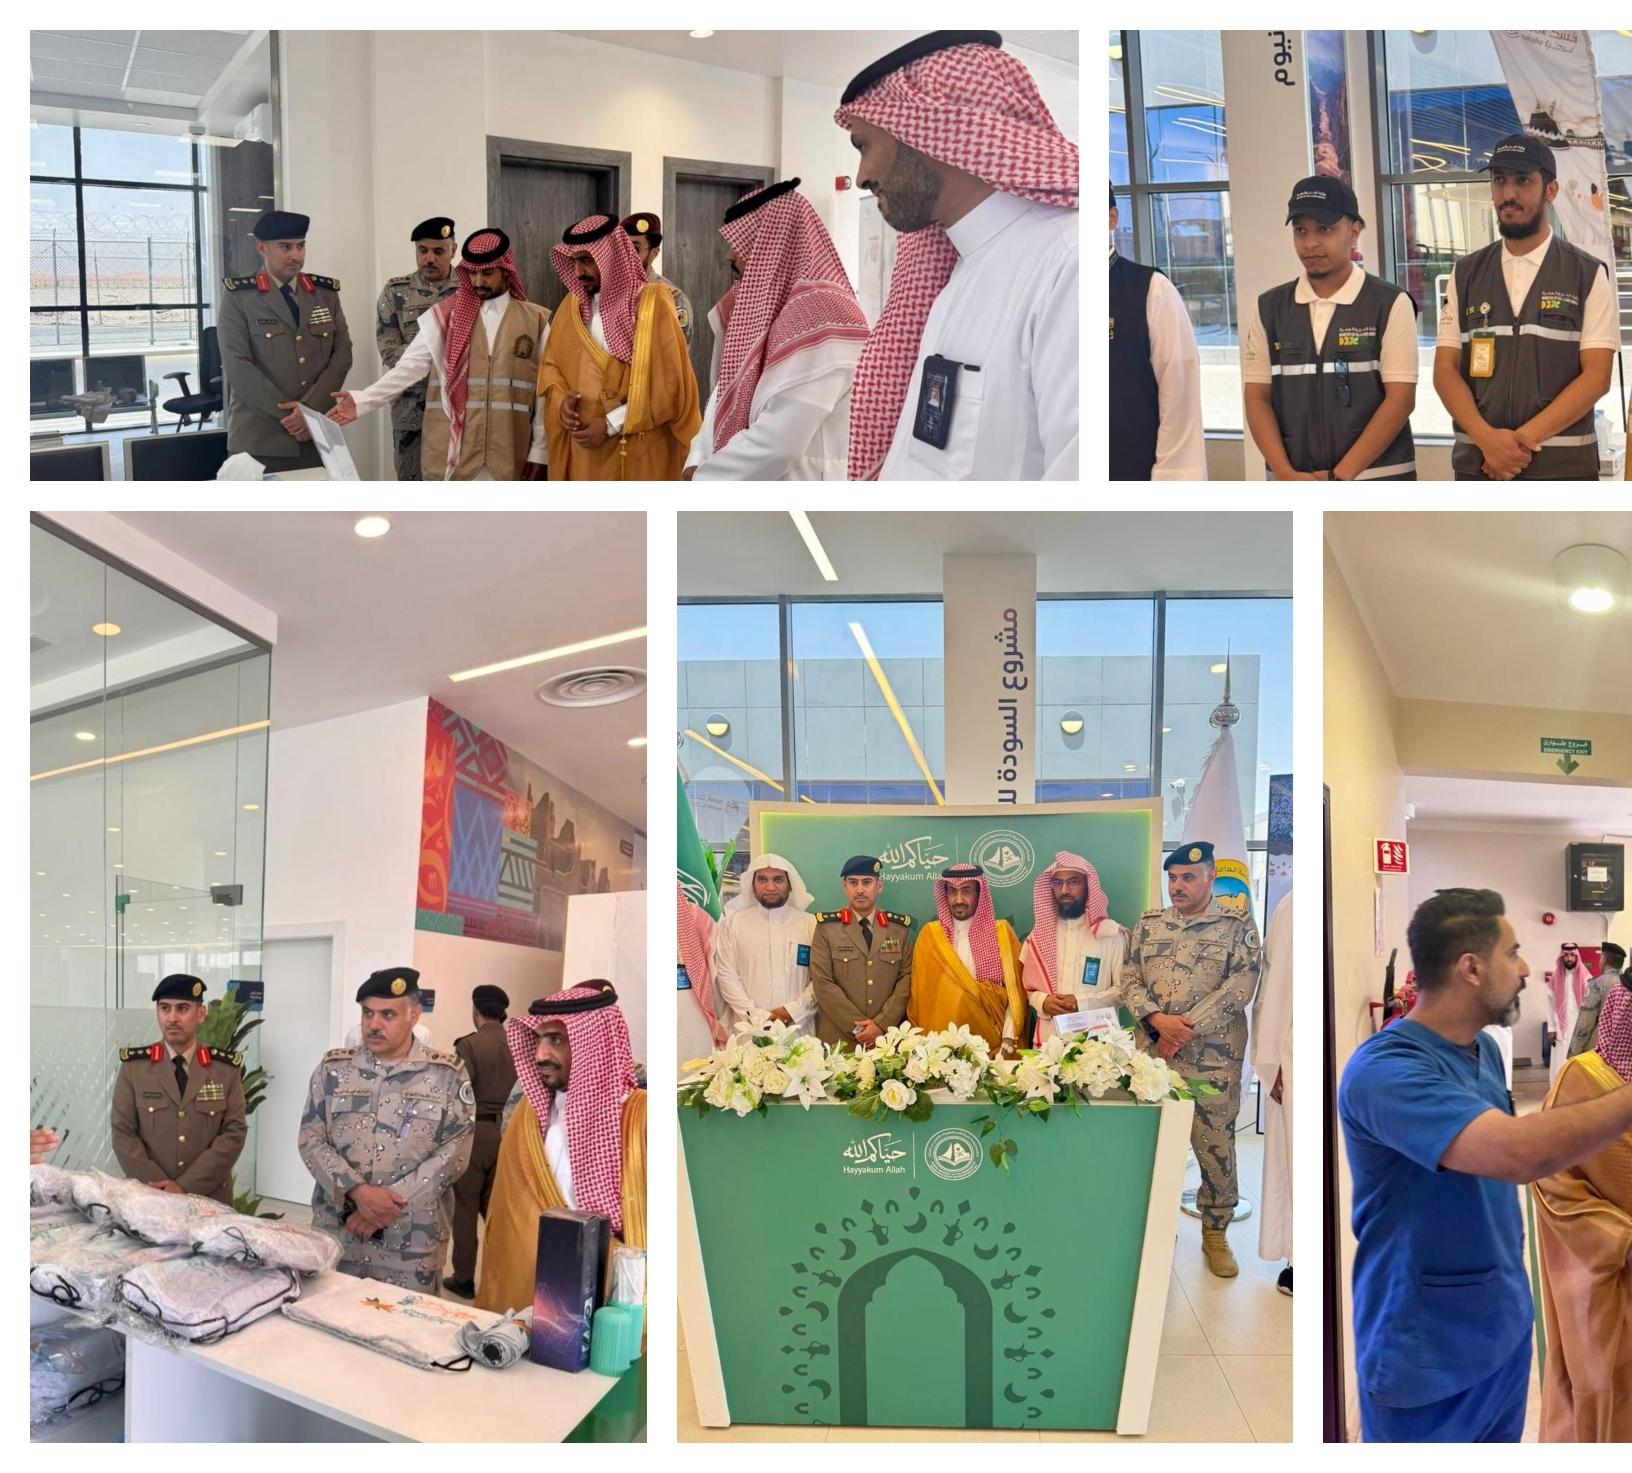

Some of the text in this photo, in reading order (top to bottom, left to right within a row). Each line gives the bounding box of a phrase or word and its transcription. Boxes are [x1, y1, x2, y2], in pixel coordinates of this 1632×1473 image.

[1268, 31, 1295, 86] نيوم
[994, 608, 1028, 691] مشروع
[997, 698, 1024, 782] السودة
[879, 871, 944, 882] Hayyakum Alla
[843, 1166, 906, 1176] Hayyakum Allah
